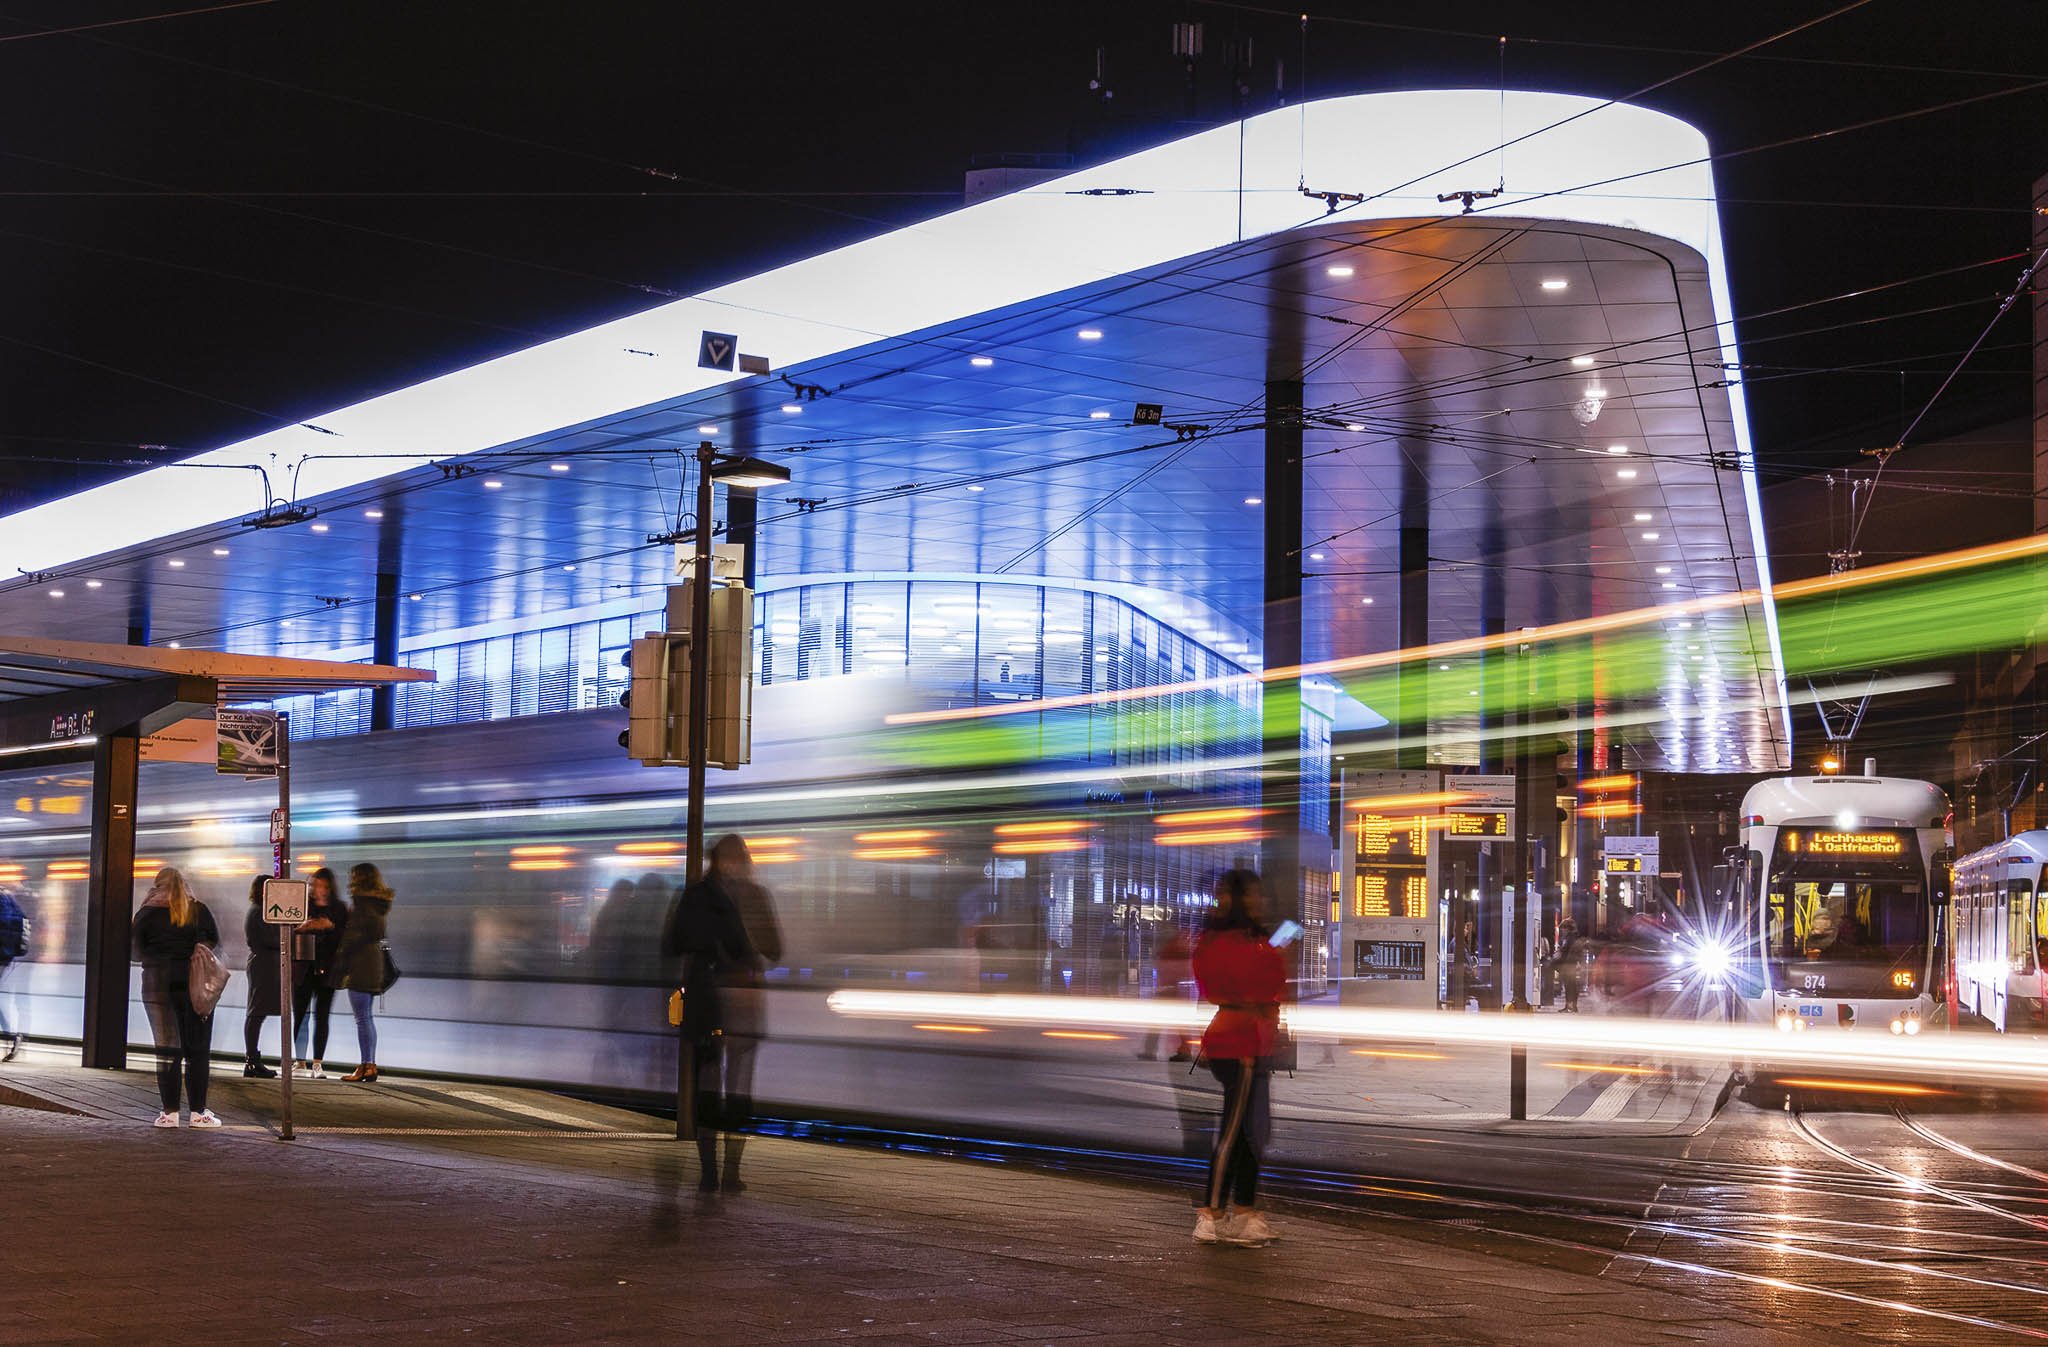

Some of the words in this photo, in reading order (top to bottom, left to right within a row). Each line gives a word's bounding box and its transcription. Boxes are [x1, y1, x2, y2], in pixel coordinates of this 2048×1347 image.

[1788, 832, 1798, 852] 1
[1814, 833, 1896, 843] Lechhausen
[1809, 842, 1823, 852] N.
[1825, 842, 1902, 852] Ostfriedhof
[1804, 975, 1826, 989] 874
